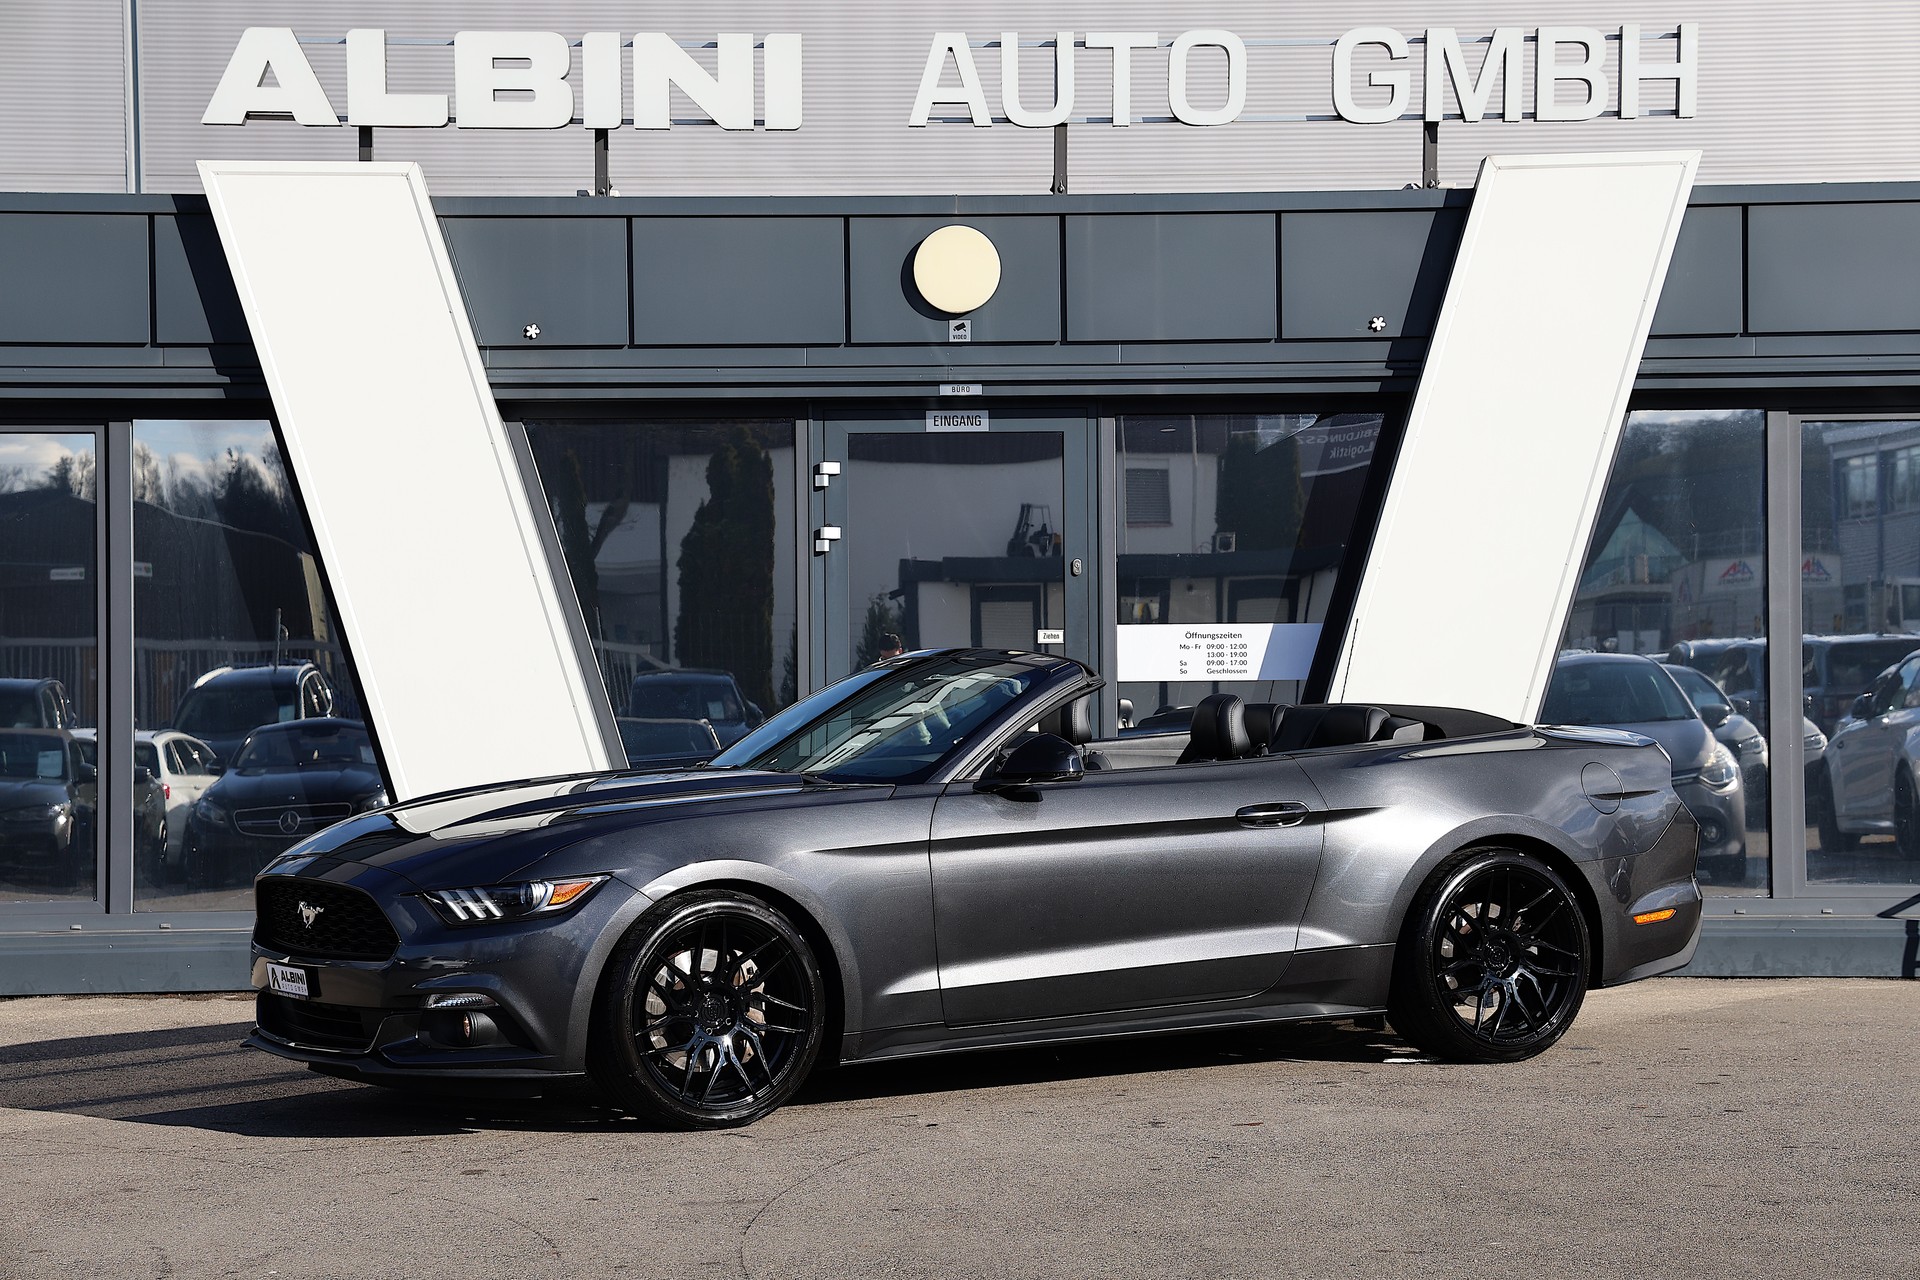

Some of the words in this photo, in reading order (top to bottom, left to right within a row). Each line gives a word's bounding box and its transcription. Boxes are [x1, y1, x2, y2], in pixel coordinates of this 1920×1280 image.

[200, 27, 803, 130] ALBINI
[908, 29, 1248, 128] AUTO
[1331, 22, 1699, 126] GMBH
[951, 385, 970, 393] BÜRO
[933, 415, 982, 427] EINGANG
[1043, 632, 1060, 640] Ziehen
[1185, 631, 1243, 640] Öffnungszeiten
[1206, 667, 1248, 675] Geschlossen
[281, 969, 306, 986] ALBINI
